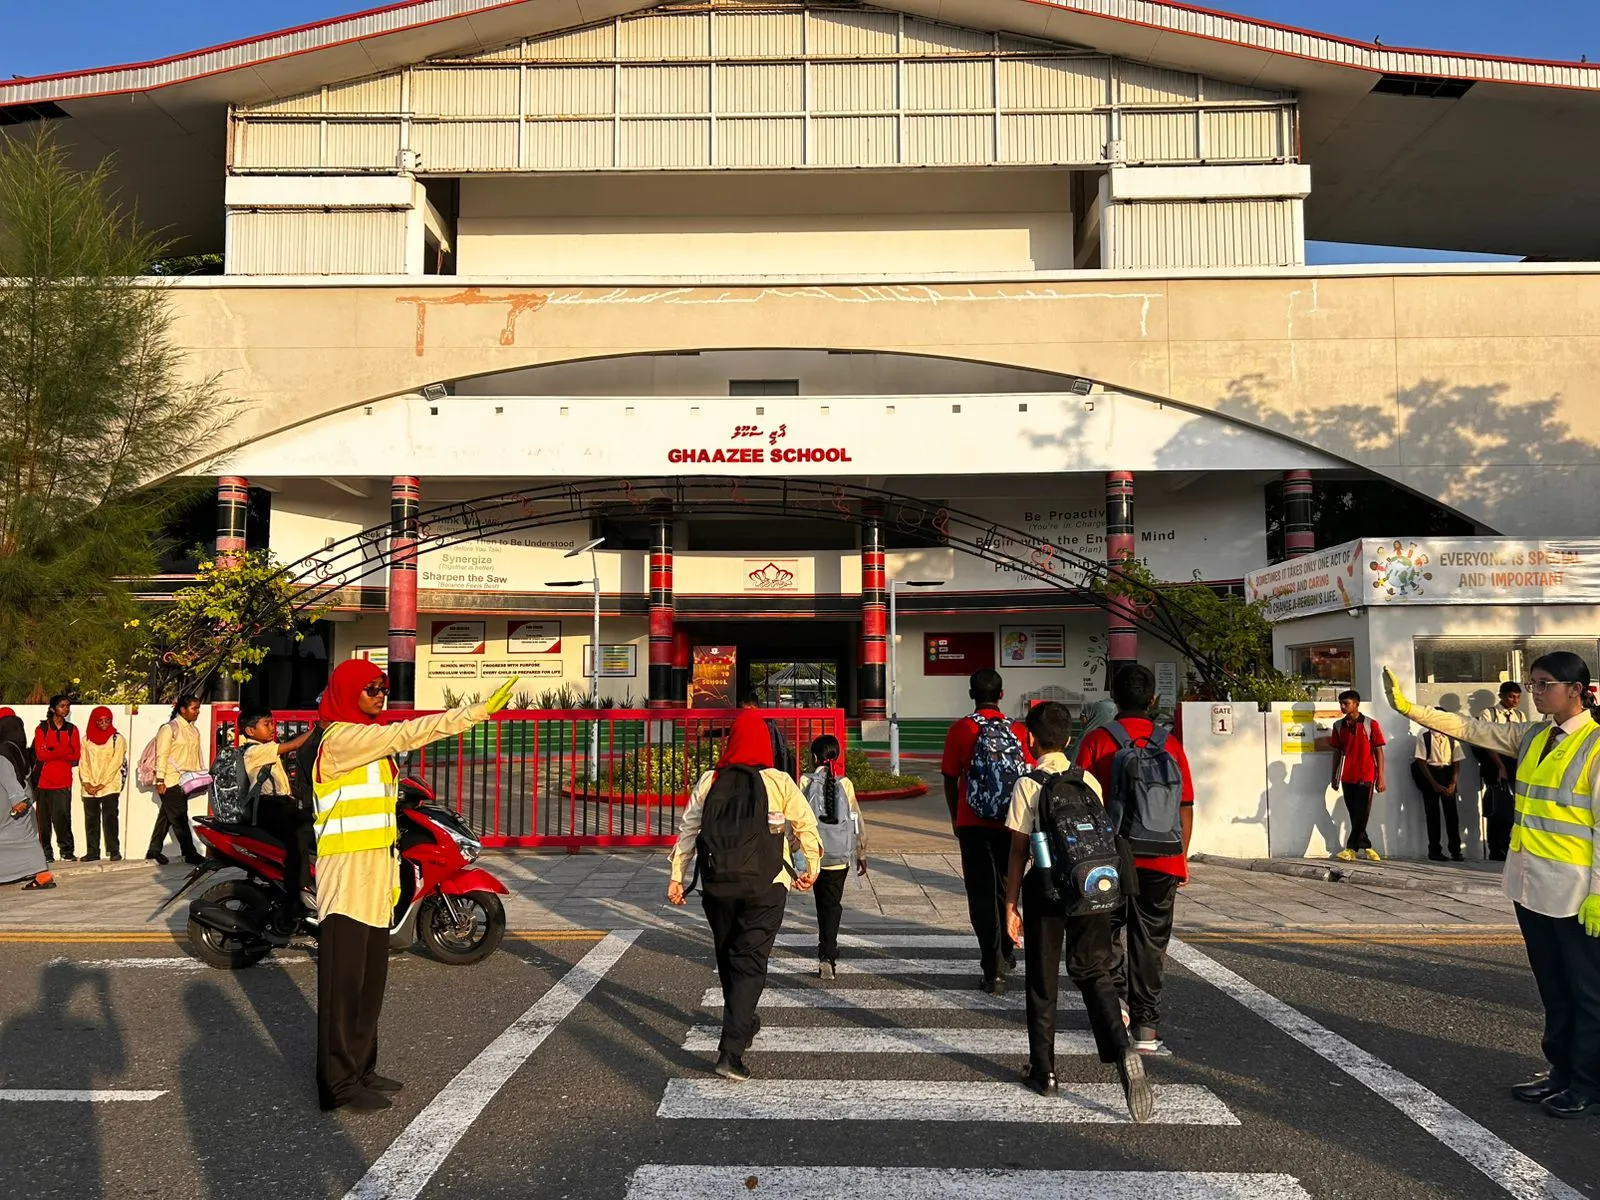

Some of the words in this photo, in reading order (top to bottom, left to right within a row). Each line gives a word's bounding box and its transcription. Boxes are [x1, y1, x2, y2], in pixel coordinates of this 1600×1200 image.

[668, 448, 764, 463] GHAAZEE
[770, 447, 852, 462] SCHOOL
[1024, 511, 1041, 521] Be
[1049, 508, 1105, 520] Proactiv
[499, 538, 508, 546] to
[510, 538, 523, 546] Be
[524, 538, 575, 548] Understood
[1058, 535, 1078, 545] the
[1141, 530, 1175, 542] Mind
[442, 553, 492, 565] Synergize
[1511, 552, 1524, 566] IS
[1256, 571, 1281, 586] SOMETIMES
[1287, 564, 1303, 578] TAKES
[1303, 560, 1319, 573] ONLY
[1318, 557, 1329, 570] ONE
[1330, 554, 1341, 567] ACT
[1343, 550, 1351, 563] OF
[422, 571, 465, 582] Sharpen
[467, 573, 484, 582] the
[486, 574, 508, 583] Saw
[1296, 580, 1307, 592] AND
[1308, 574, 1330, 589] CARING
[1459, 573, 1486, 587] AND
[1491, 572, 1564, 587] IMPORTANT
[1213, 707, 1231, 715] GATE
[1218, 719, 1227, 731] 1
